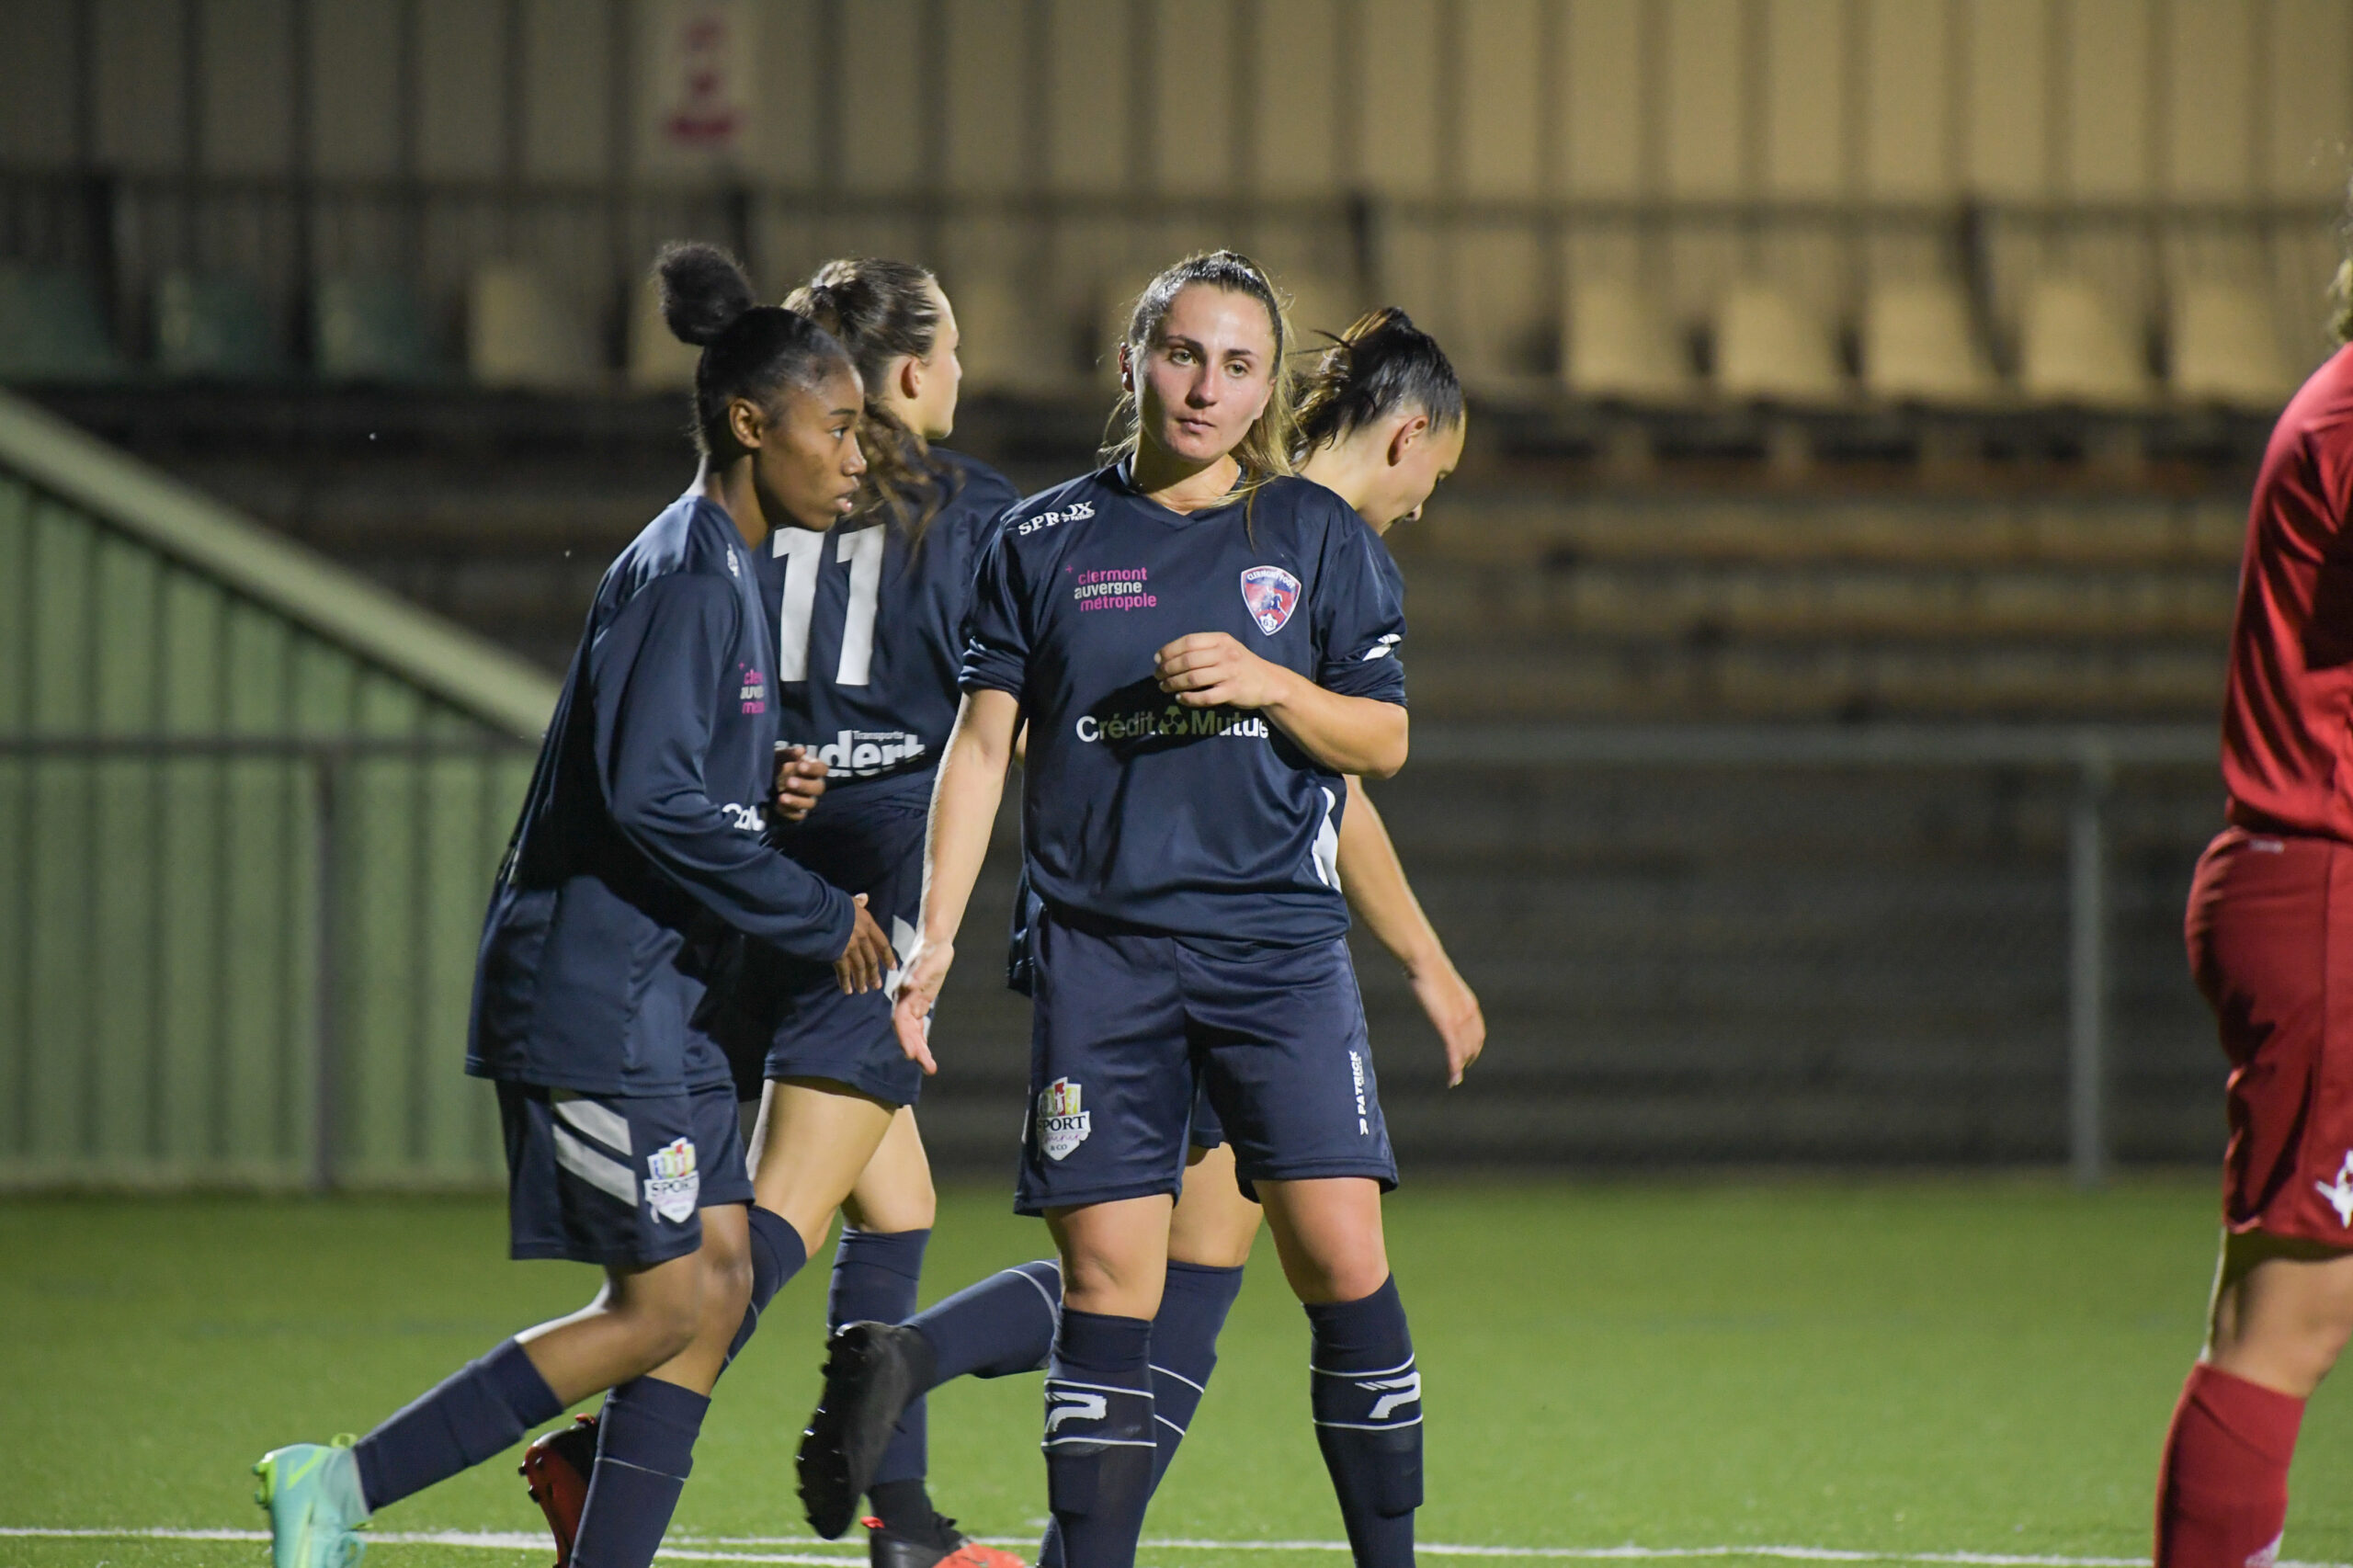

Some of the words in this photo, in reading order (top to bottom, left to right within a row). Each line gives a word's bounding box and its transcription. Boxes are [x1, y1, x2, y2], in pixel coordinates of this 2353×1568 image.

[1078, 567, 1147, 585] clermont
[1074, 582, 1142, 599] auvergne
[772, 525, 887, 686] 11
[1076, 711, 1155, 742] Crédit
[1191, 710, 1269, 738] Mutue
